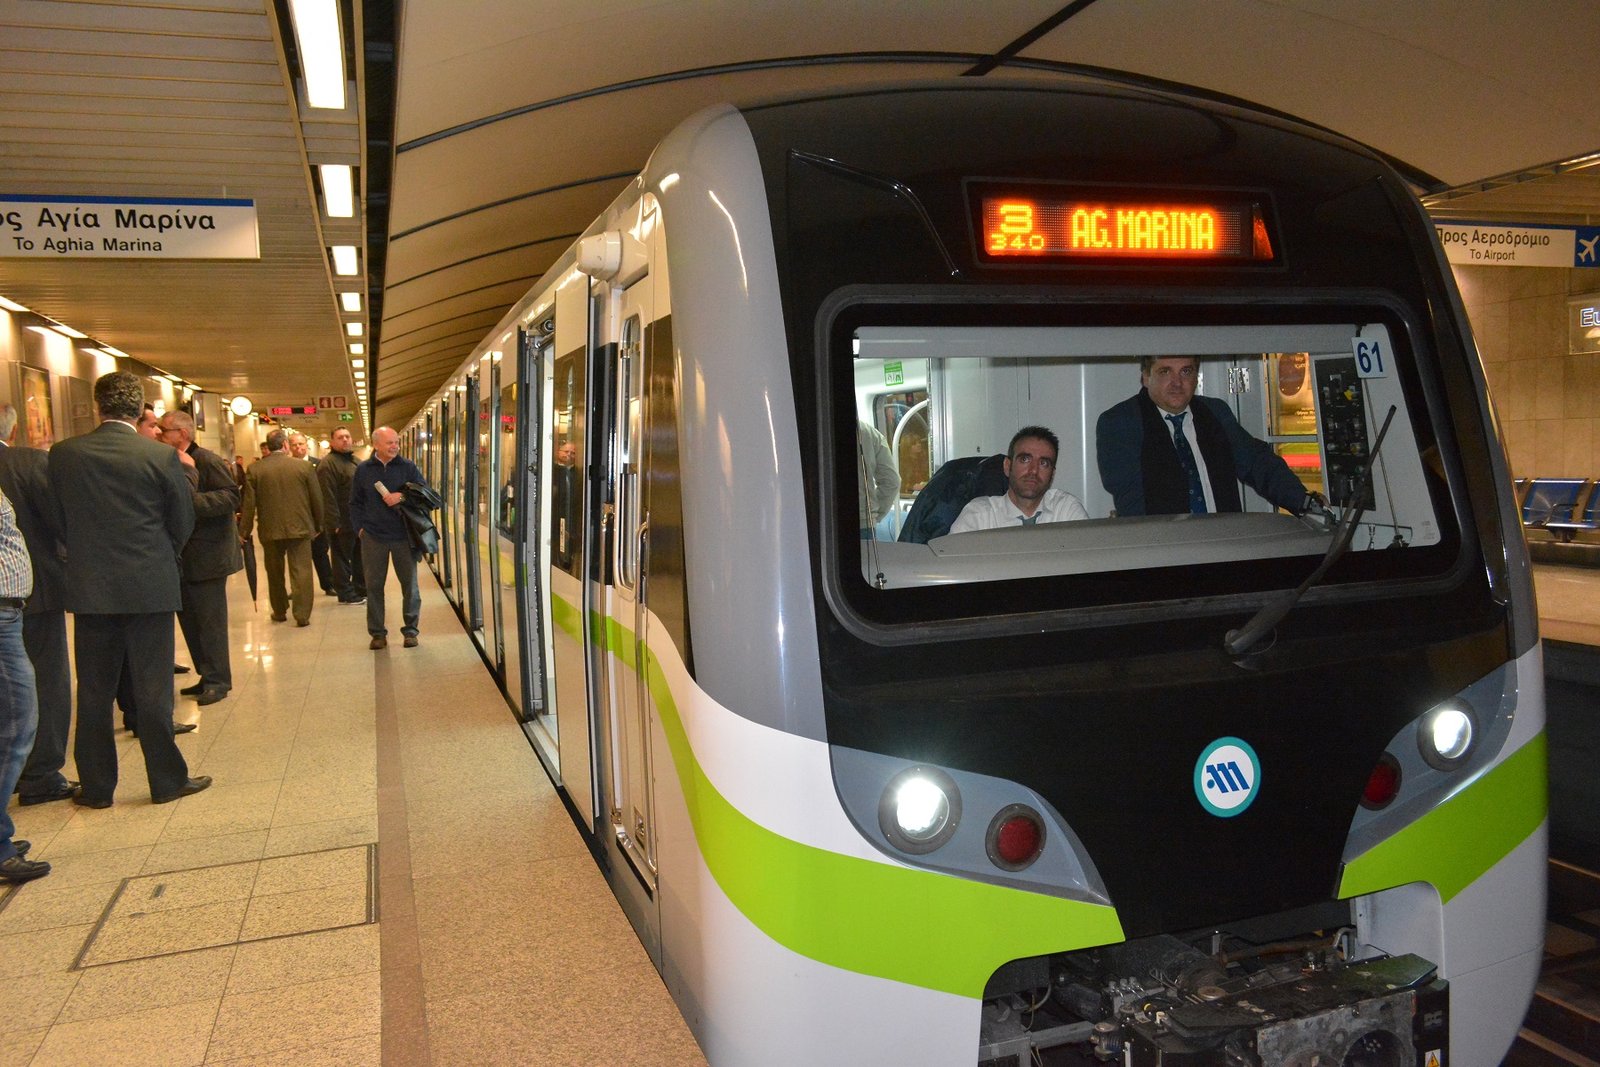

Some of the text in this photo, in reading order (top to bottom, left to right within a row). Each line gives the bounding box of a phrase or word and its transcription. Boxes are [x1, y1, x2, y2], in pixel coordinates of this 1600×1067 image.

[37, 208, 100, 232] Αγία
[115, 208, 216, 233] Μαρίνα
[1000, 204, 1032, 233] 3
[1117, 210, 1213, 250] MARINA
[1471, 230, 1550, 248] Αεροδρόμιο
[13, 236, 162, 253] To Aghia Marina
[991, 233, 1044, 250] 340
[1470, 249, 1515, 262] To Airport
[1357, 341, 1384, 373] 61
